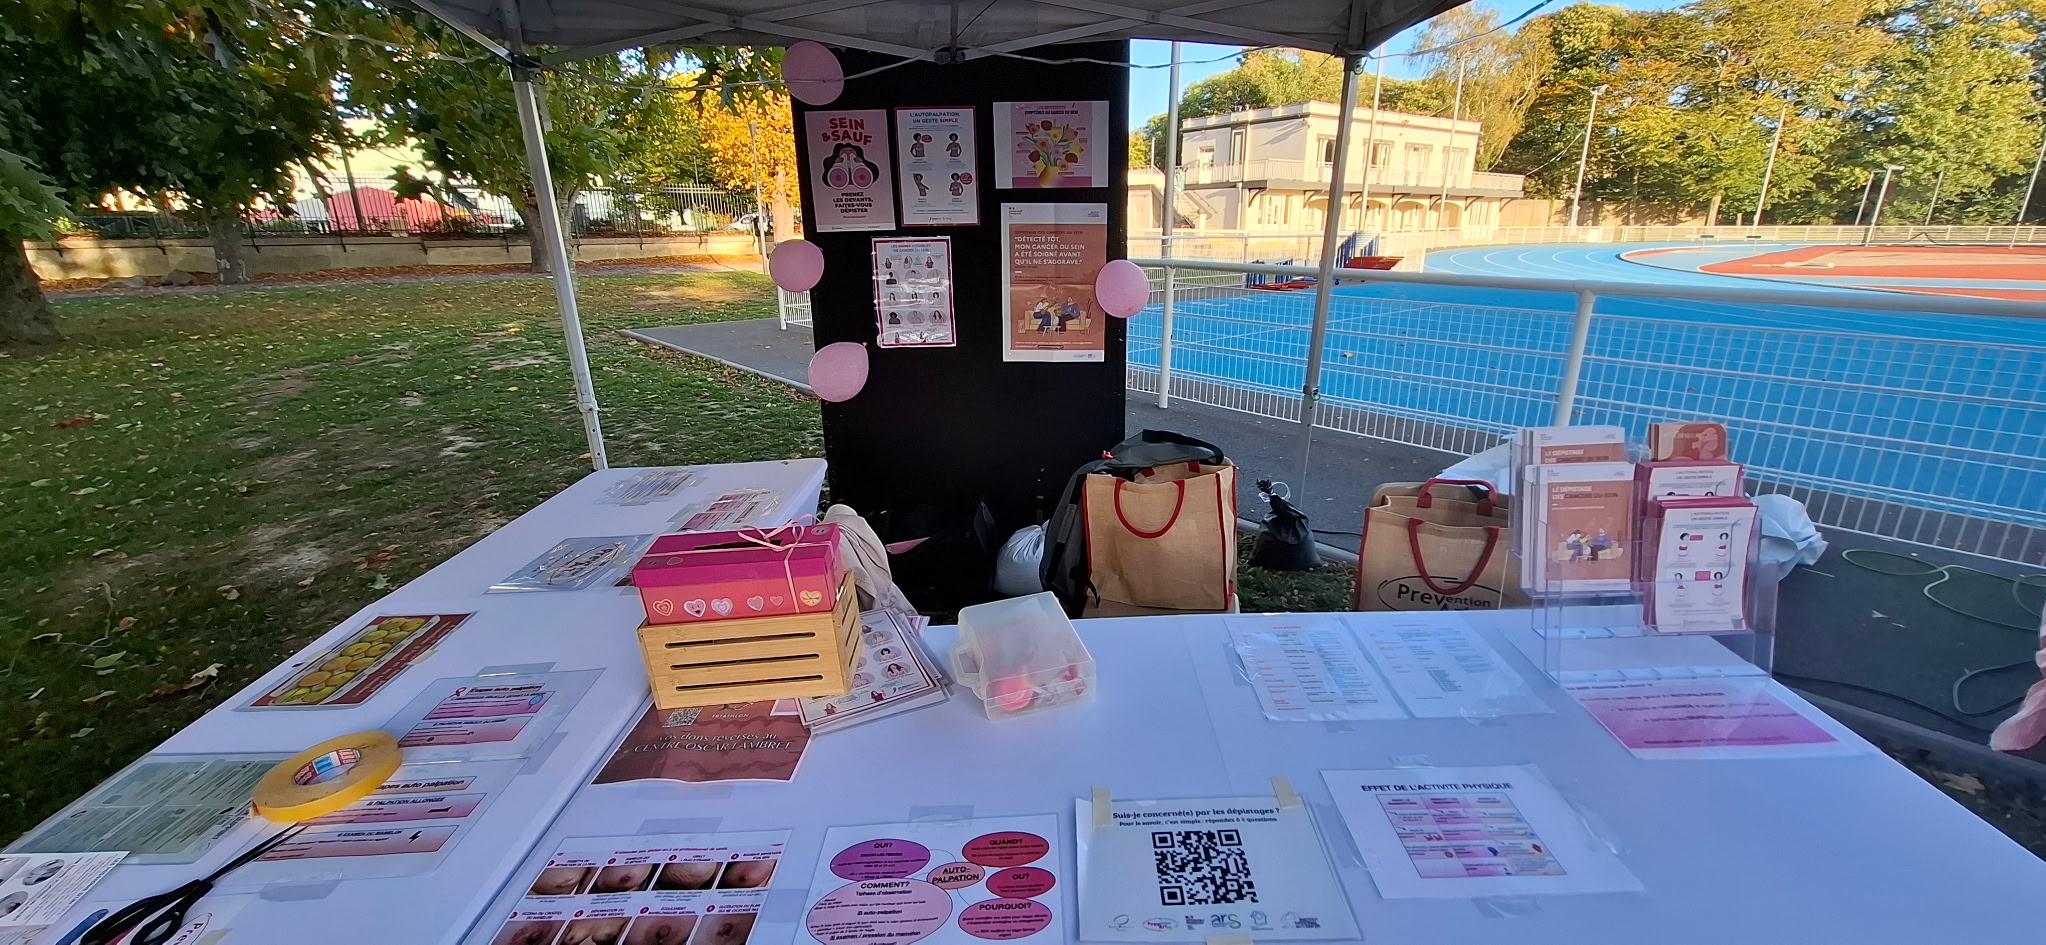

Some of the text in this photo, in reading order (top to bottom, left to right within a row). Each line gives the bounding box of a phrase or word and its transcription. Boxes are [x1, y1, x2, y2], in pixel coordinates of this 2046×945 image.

[829, 117, 865, 130] SEIN
[1397, 583, 1491, 608] Prevention
[680, 732, 709, 741] dons
[634, 741, 791, 752] CENTRE OSCAR LAMBRET
[421, 780, 465, 788] palpation
[1112, 811, 1141, 819] Suis-je
[1142, 810, 1194, 818] concerné(e)
[1227, 807, 1274, 815] dépistages
[942, 866, 970, 875] AUTO-
[931, 873, 980, 884] PALPATION
[860, 881, 910, 889] COMMENT?
[979, 902, 1032, 911] POURQUOI?
[1211, 913, 1242, 930] ars
